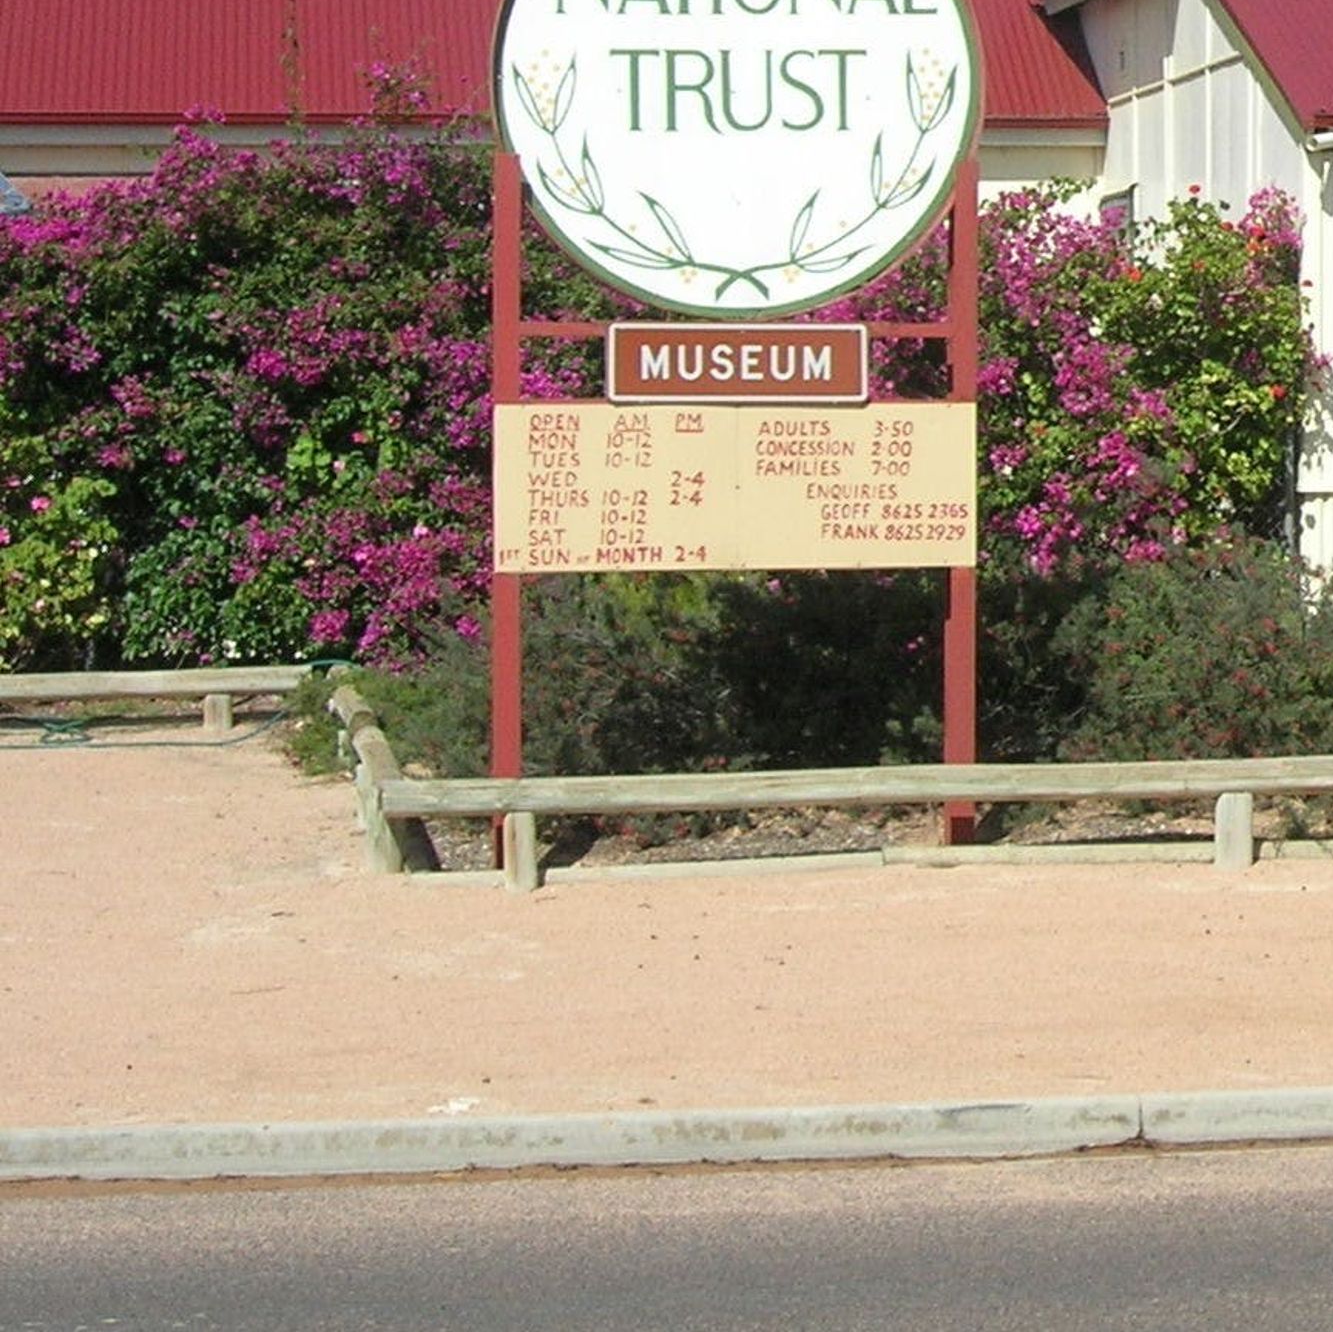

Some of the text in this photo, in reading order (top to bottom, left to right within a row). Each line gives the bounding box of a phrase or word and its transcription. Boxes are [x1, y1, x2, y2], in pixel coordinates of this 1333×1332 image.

[609, 48, 867, 135] TRUST
[640, 344, 832, 381] MUSEUM
[530, 413, 580, 431] OPEN
[758, 420, 831, 436] ADULTS
[529, 432, 652, 450] MON 10-12
[756, 440, 855, 457] CONCESSION
[530, 451, 652, 468] TUES 10-12
[756, 459, 841, 476] FAMILIES
[528, 470, 706, 487] WED 2-4
[528, 489, 704, 508] THURS 10-12 2-4
[806, 483, 898, 500] ENQUIRIES
[528, 509, 648, 526] FRI 10-12
[820, 503, 872, 520] GEOFF
[528, 528, 645, 546] SAT 10-12
[820, 523, 879, 540] FRANK
[529, 548, 570, 566] SUN
[596, 546, 663, 565] MONTH
[675, 545, 707, 563] 2-4
